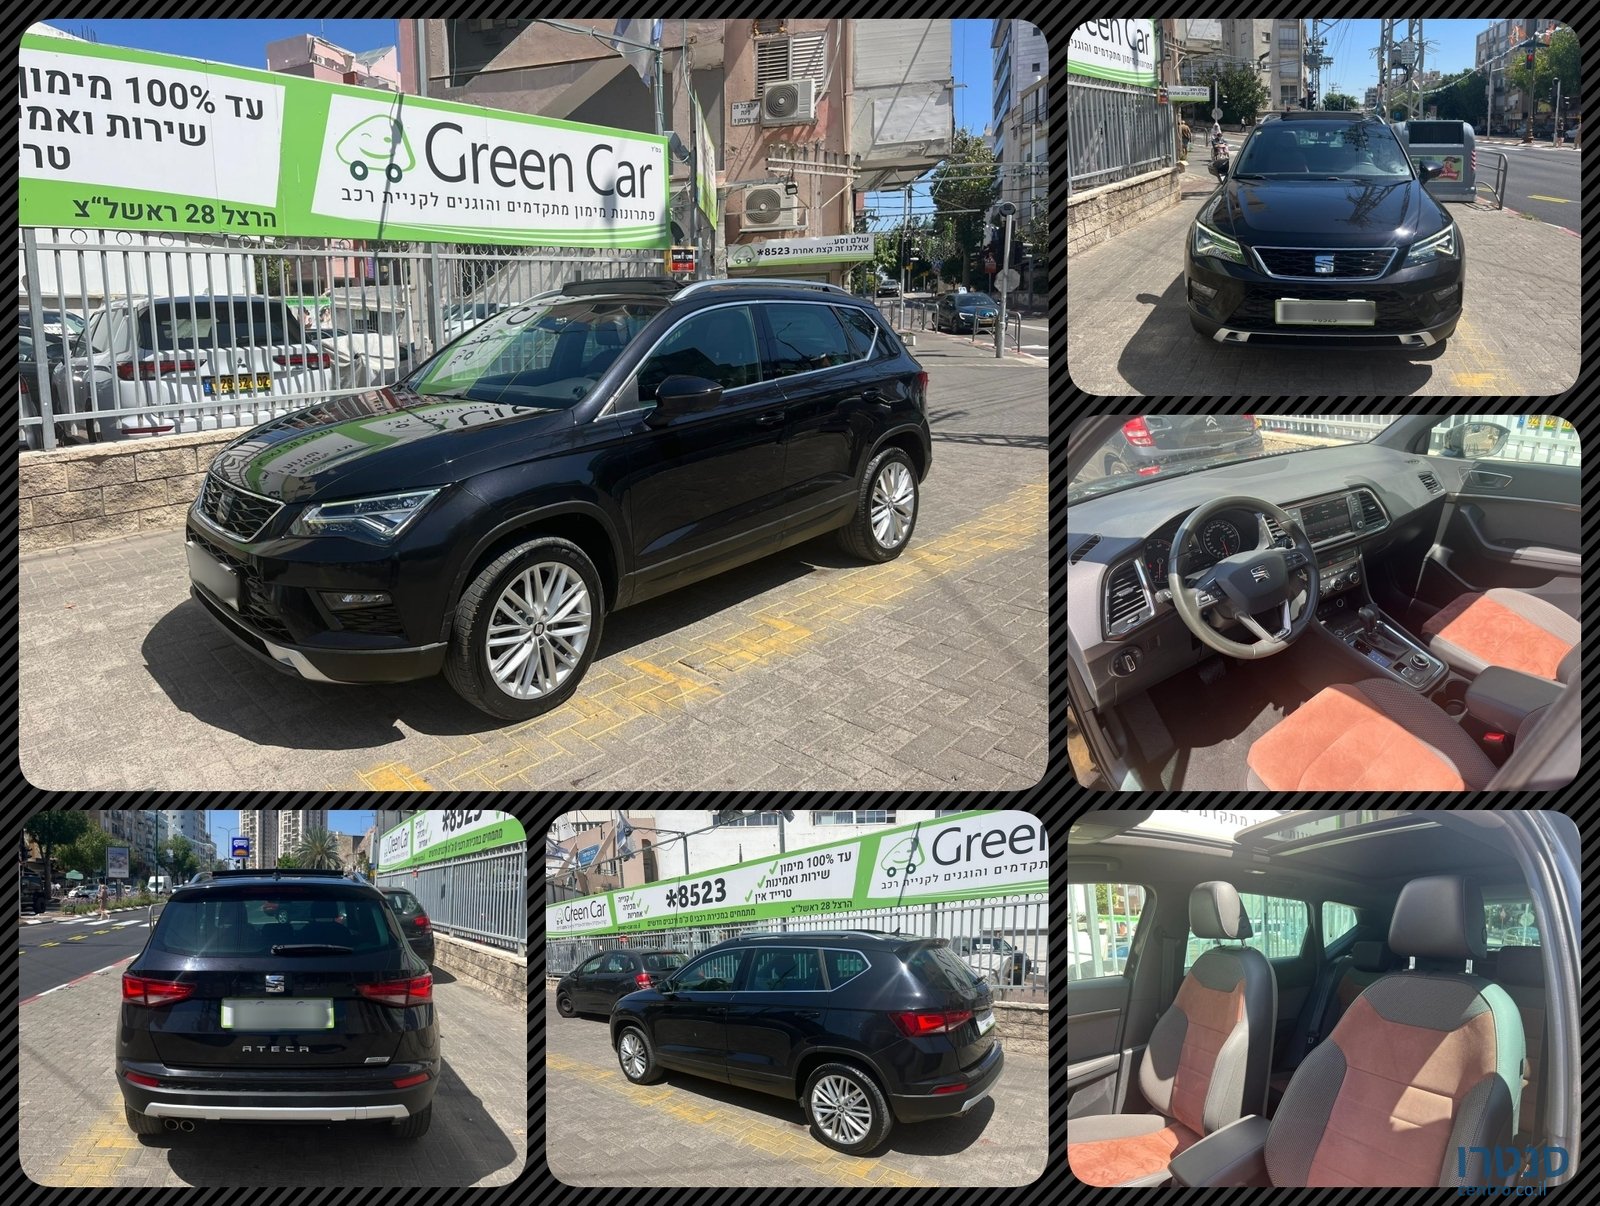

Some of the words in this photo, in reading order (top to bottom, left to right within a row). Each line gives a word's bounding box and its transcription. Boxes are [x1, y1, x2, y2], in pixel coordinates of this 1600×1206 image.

[1125, 19, 1150, 55] Car
[1068, 39, 1091, 52] והוגני
[126, 76, 216, 114] 100%
[225, 94, 264, 120] עד
[19, 104, 94, 134] ואמ
[106, 113, 206, 146] שירות
[425, 121, 574, 193] Green
[586, 143, 653, 199] Car
[342, 188, 374, 202] רכב
[382, 192, 438, 210] לקניית
[447, 196, 500, 212] והוגנים
[507, 200, 569, 218] מתקדמים
[184, 203, 215, 224] 28
[222, 204, 276, 228] הרצל
[574, 205, 606, 220] מימון
[611, 208, 655, 220] פתרונות
[816, 246, 832, 254] קצת
[807, 854, 834, 868] 100%
[837, 851, 851, 862] עד
[780, 862, 804, 875] מימון
[944, 867, 988, 881] והוגנים
[766, 874, 798, 888] ואמינות
[801, 870, 830, 882] שירות
[903, 874, 939, 887] לקניית
[881, 879, 898, 889] רכב
[755, 892, 766, 904] אין
[770, 889, 792, 899] טרייד
[565, 906, 588, 922] Green
[590, 900, 606, 918] Car
[821, 902, 830, 910] 28
[833, 900, 852, 909] הרצל
[729, 908, 755, 918] מתמחים
